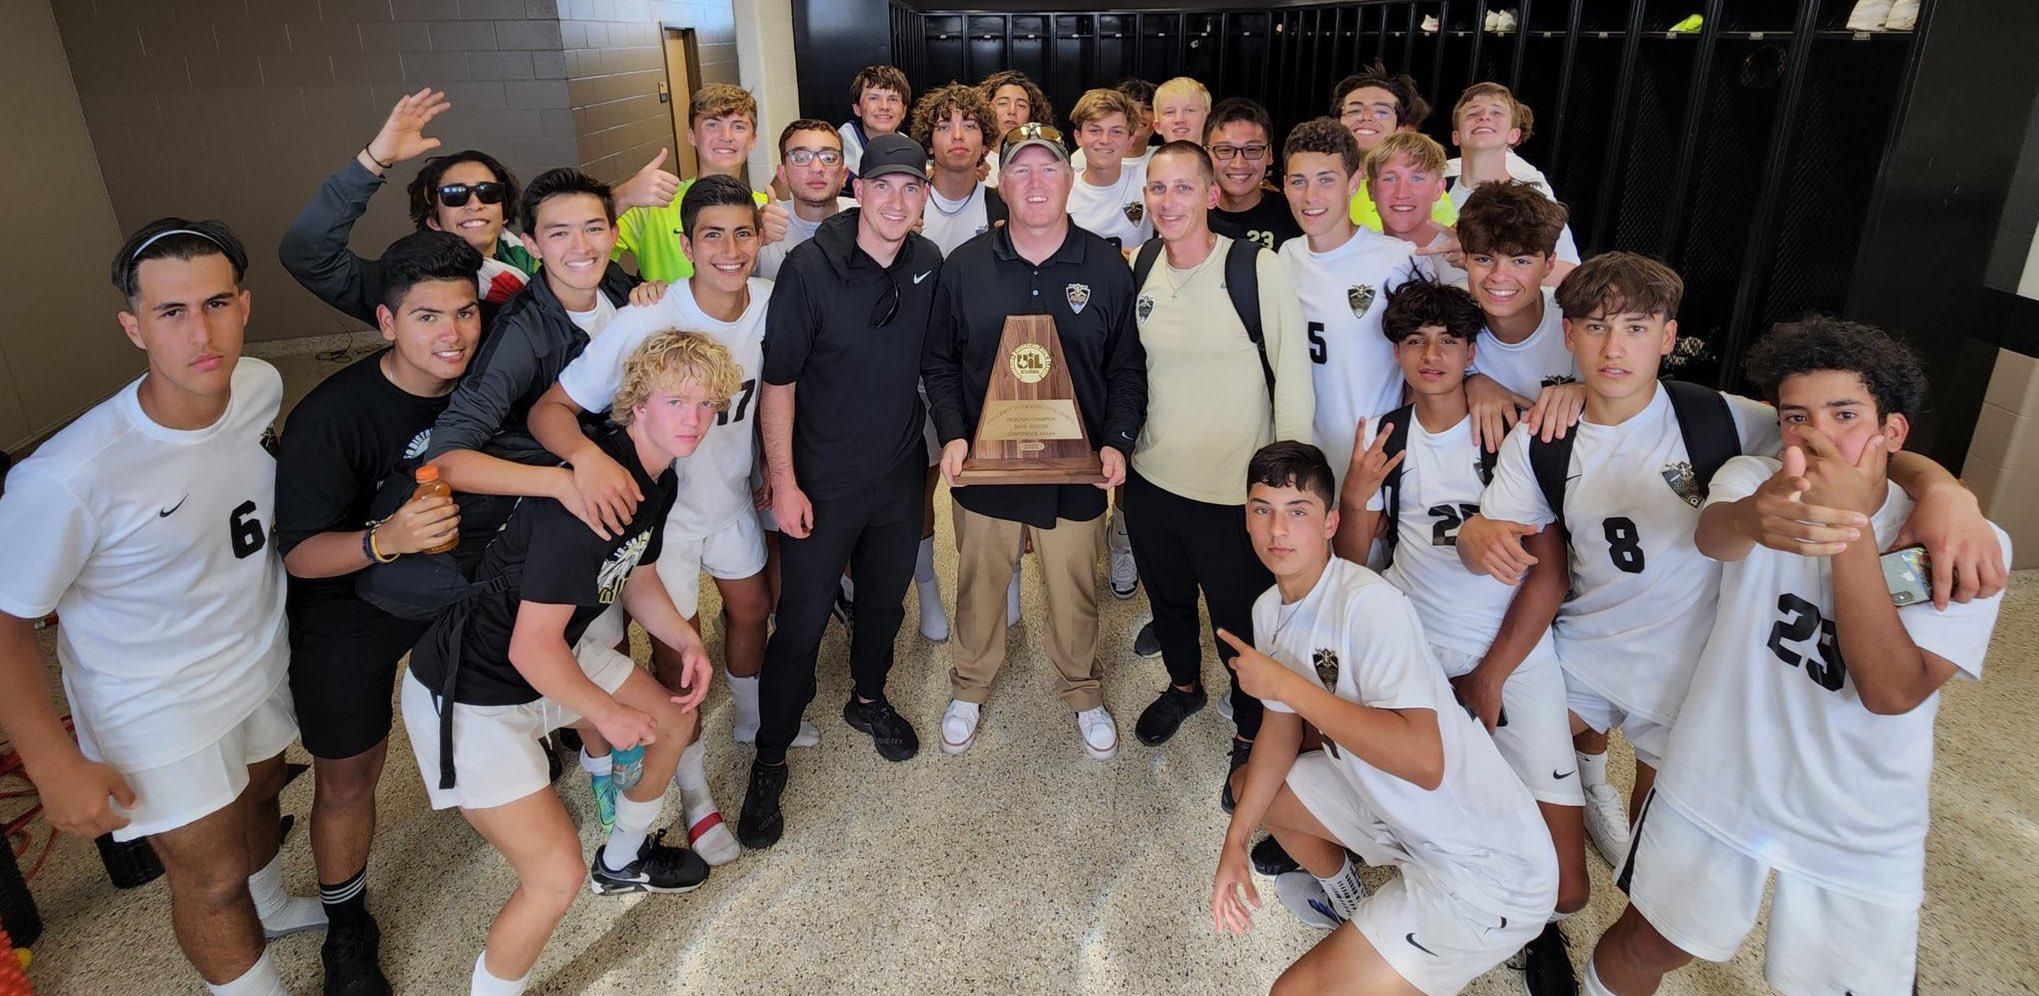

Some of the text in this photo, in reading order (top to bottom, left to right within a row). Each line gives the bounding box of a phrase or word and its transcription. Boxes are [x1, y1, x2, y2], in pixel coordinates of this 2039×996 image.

[1246, 229, 1274, 250] 23
[1308, 322, 1328, 365] 5
[229, 499, 266, 560] 6
[1601, 516, 1645, 574] 8
